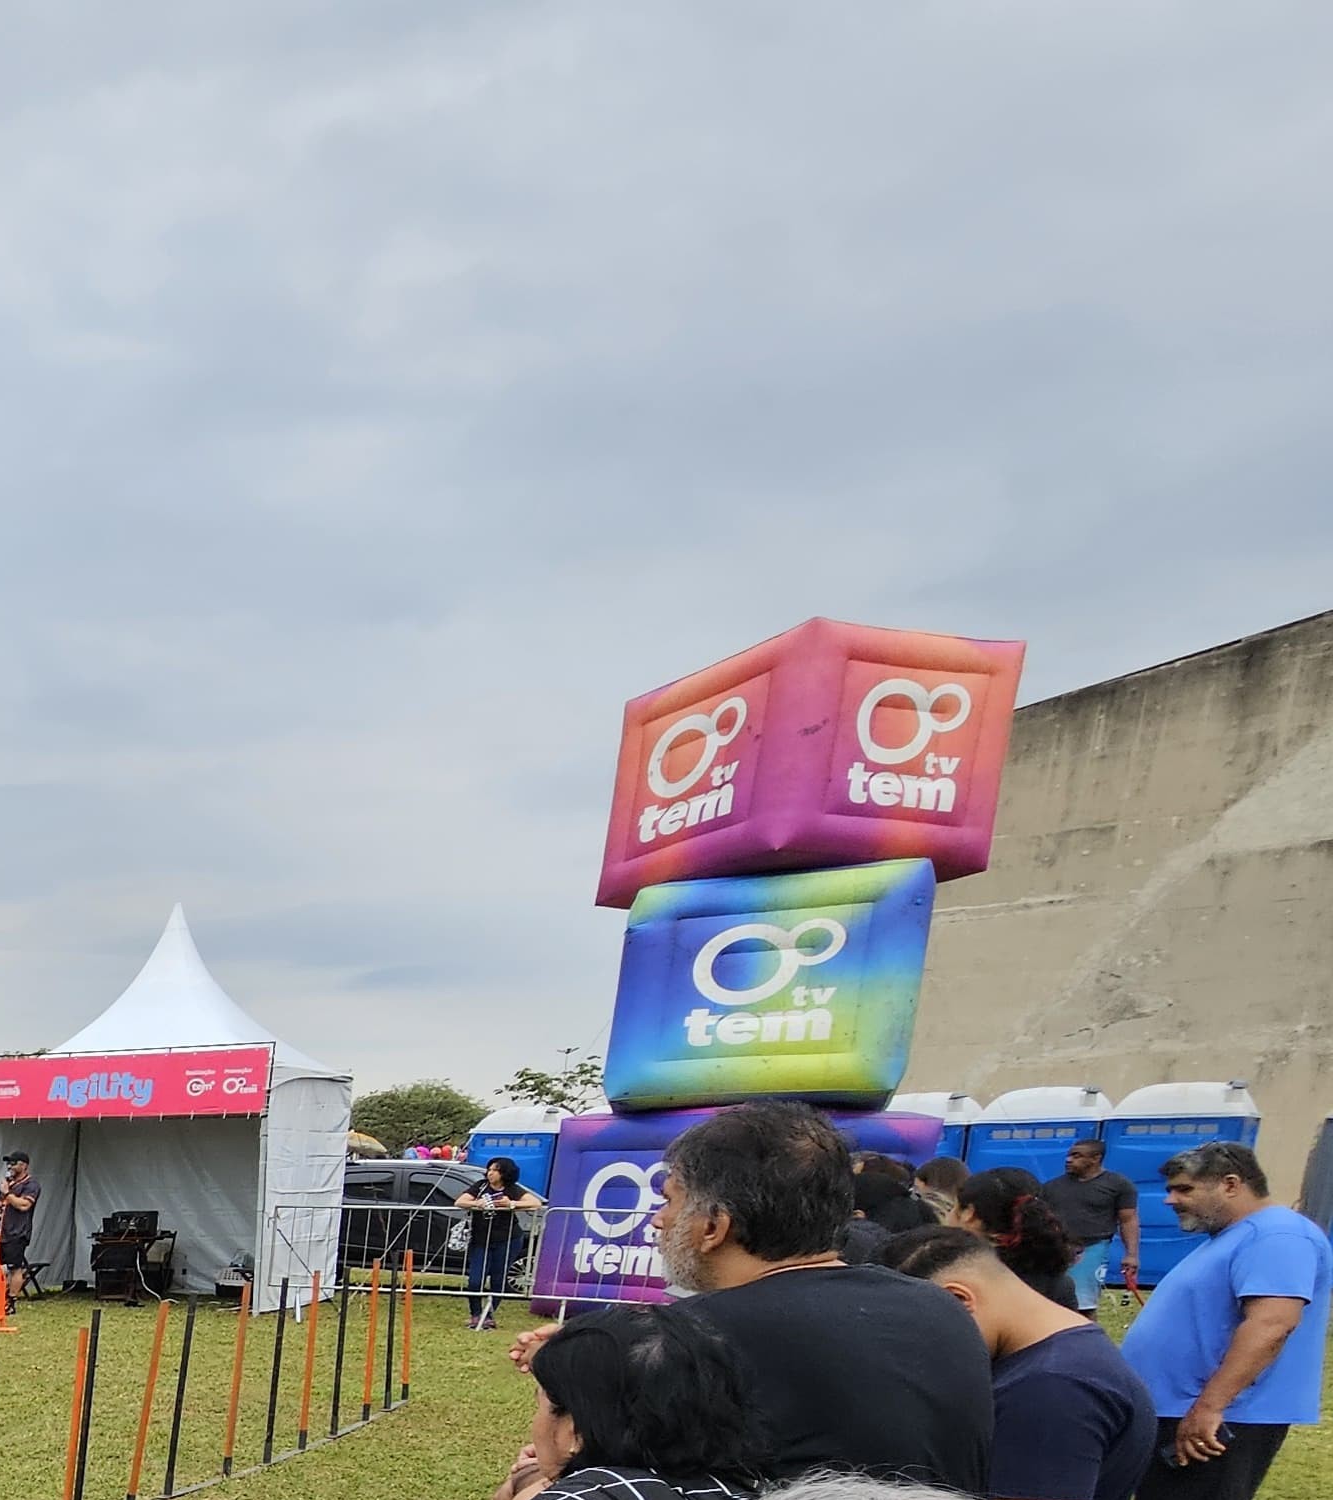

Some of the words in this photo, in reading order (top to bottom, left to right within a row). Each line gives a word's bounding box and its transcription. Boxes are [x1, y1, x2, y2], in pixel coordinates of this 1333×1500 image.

[710, 760, 740, 787] tv
[924, 752, 960, 775] tv
[847, 761, 957, 813] tem
[637, 783, 735, 844] tem
[791, 985, 837, 1006] tv
[684, 1008, 832, 1047] tem
[47, 1071, 154, 1108] Agility
